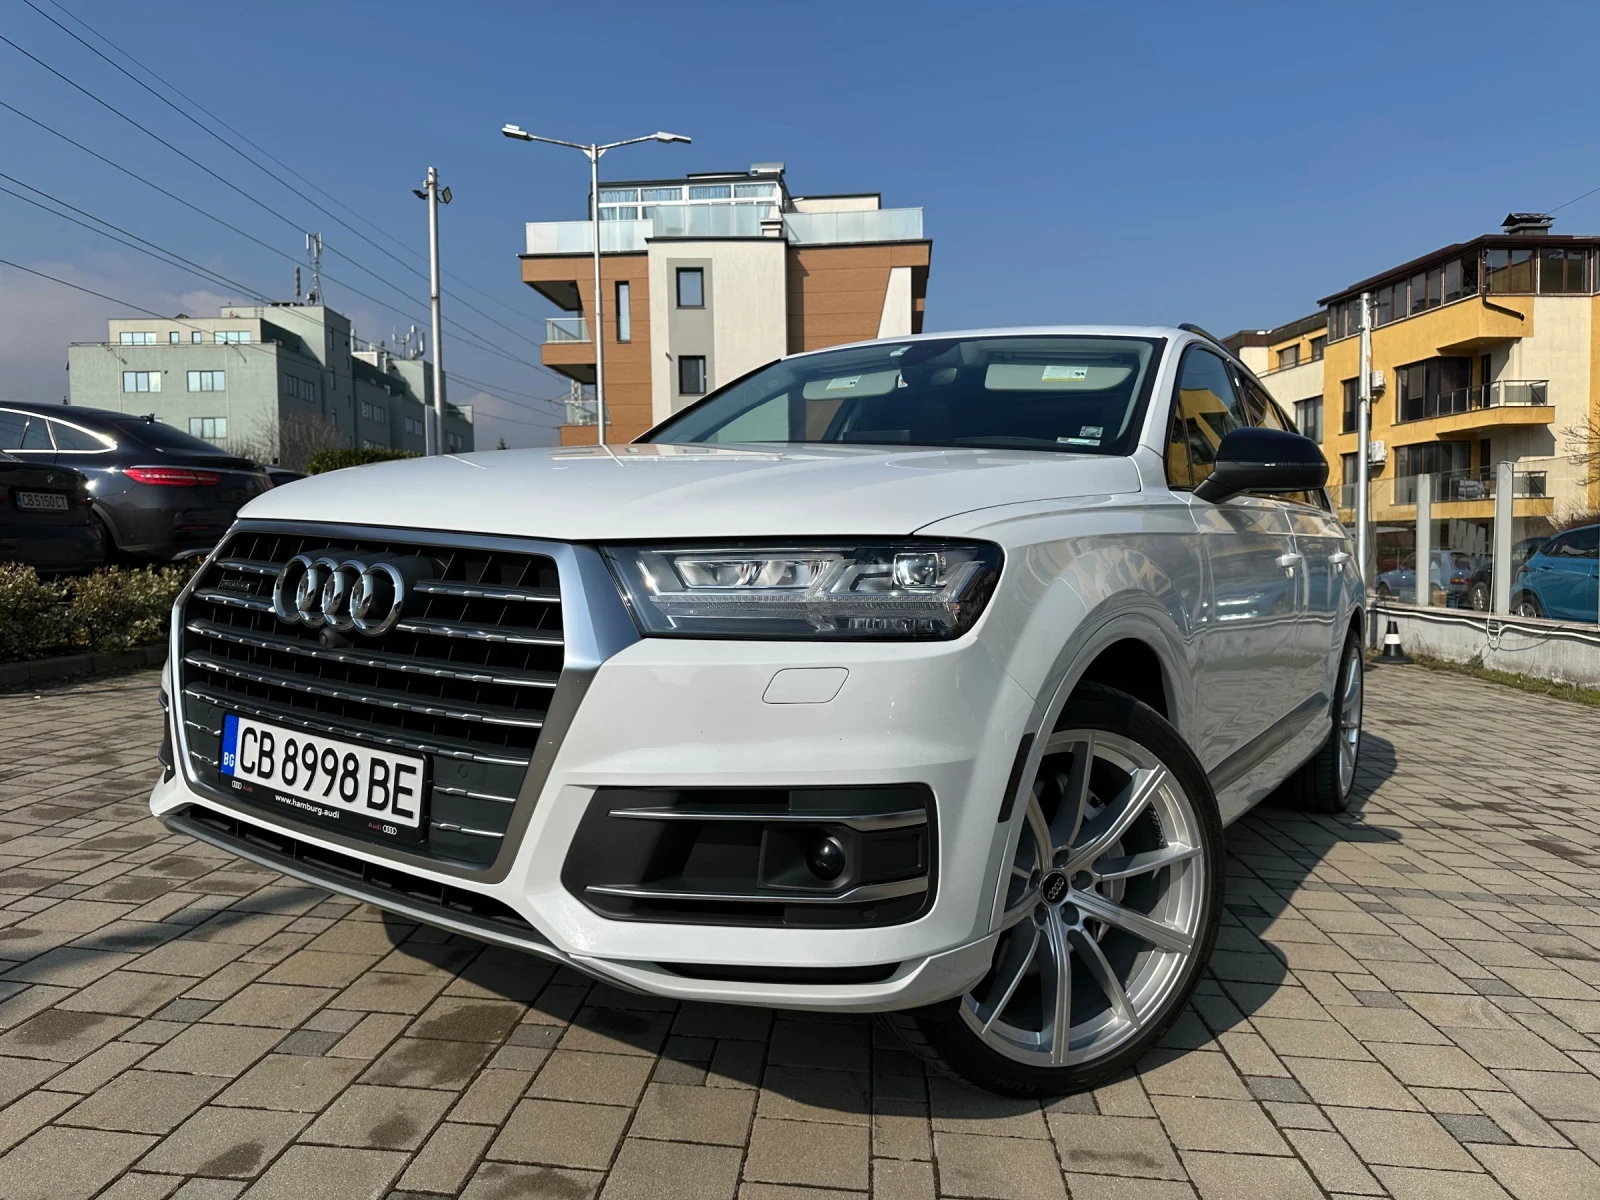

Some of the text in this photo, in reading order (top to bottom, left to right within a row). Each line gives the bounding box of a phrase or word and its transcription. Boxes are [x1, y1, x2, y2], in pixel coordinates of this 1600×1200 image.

[22, 494, 66, 508] CB 5150 CT
[223, 751, 235, 768] BG
[240, 727, 418, 818] CB 8998 BE
[274, 794, 340, 819] www.hamburg.audi
[368, 822, 382, 831] Audi
